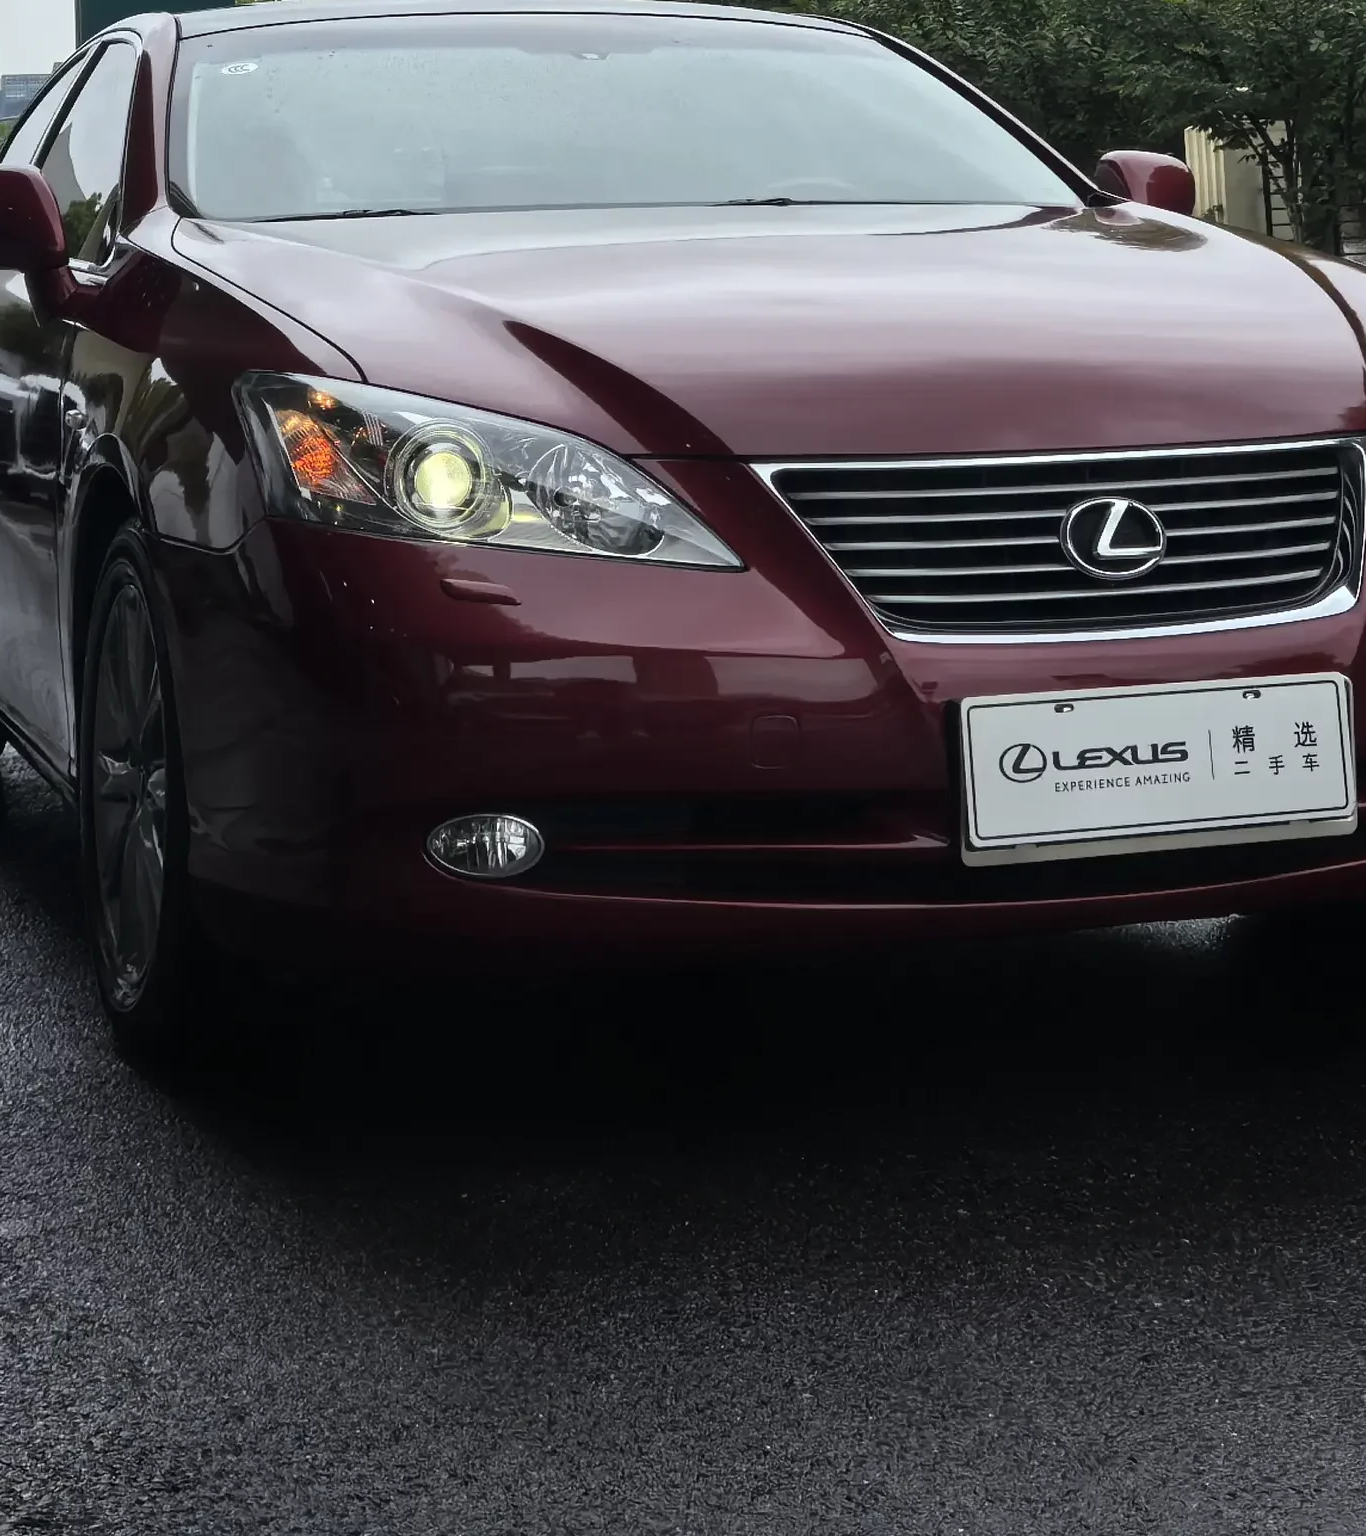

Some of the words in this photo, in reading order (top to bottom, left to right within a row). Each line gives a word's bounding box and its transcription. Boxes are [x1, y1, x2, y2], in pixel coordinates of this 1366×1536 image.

[1232, 721, 1317, 754] 精选
[1052, 741, 1189, 771] LEXUS
[1234, 753, 1320, 775] 二手车
[1055, 777, 1131, 793] EXPERIENCE
[1135, 772, 1191, 786] AMAZING
